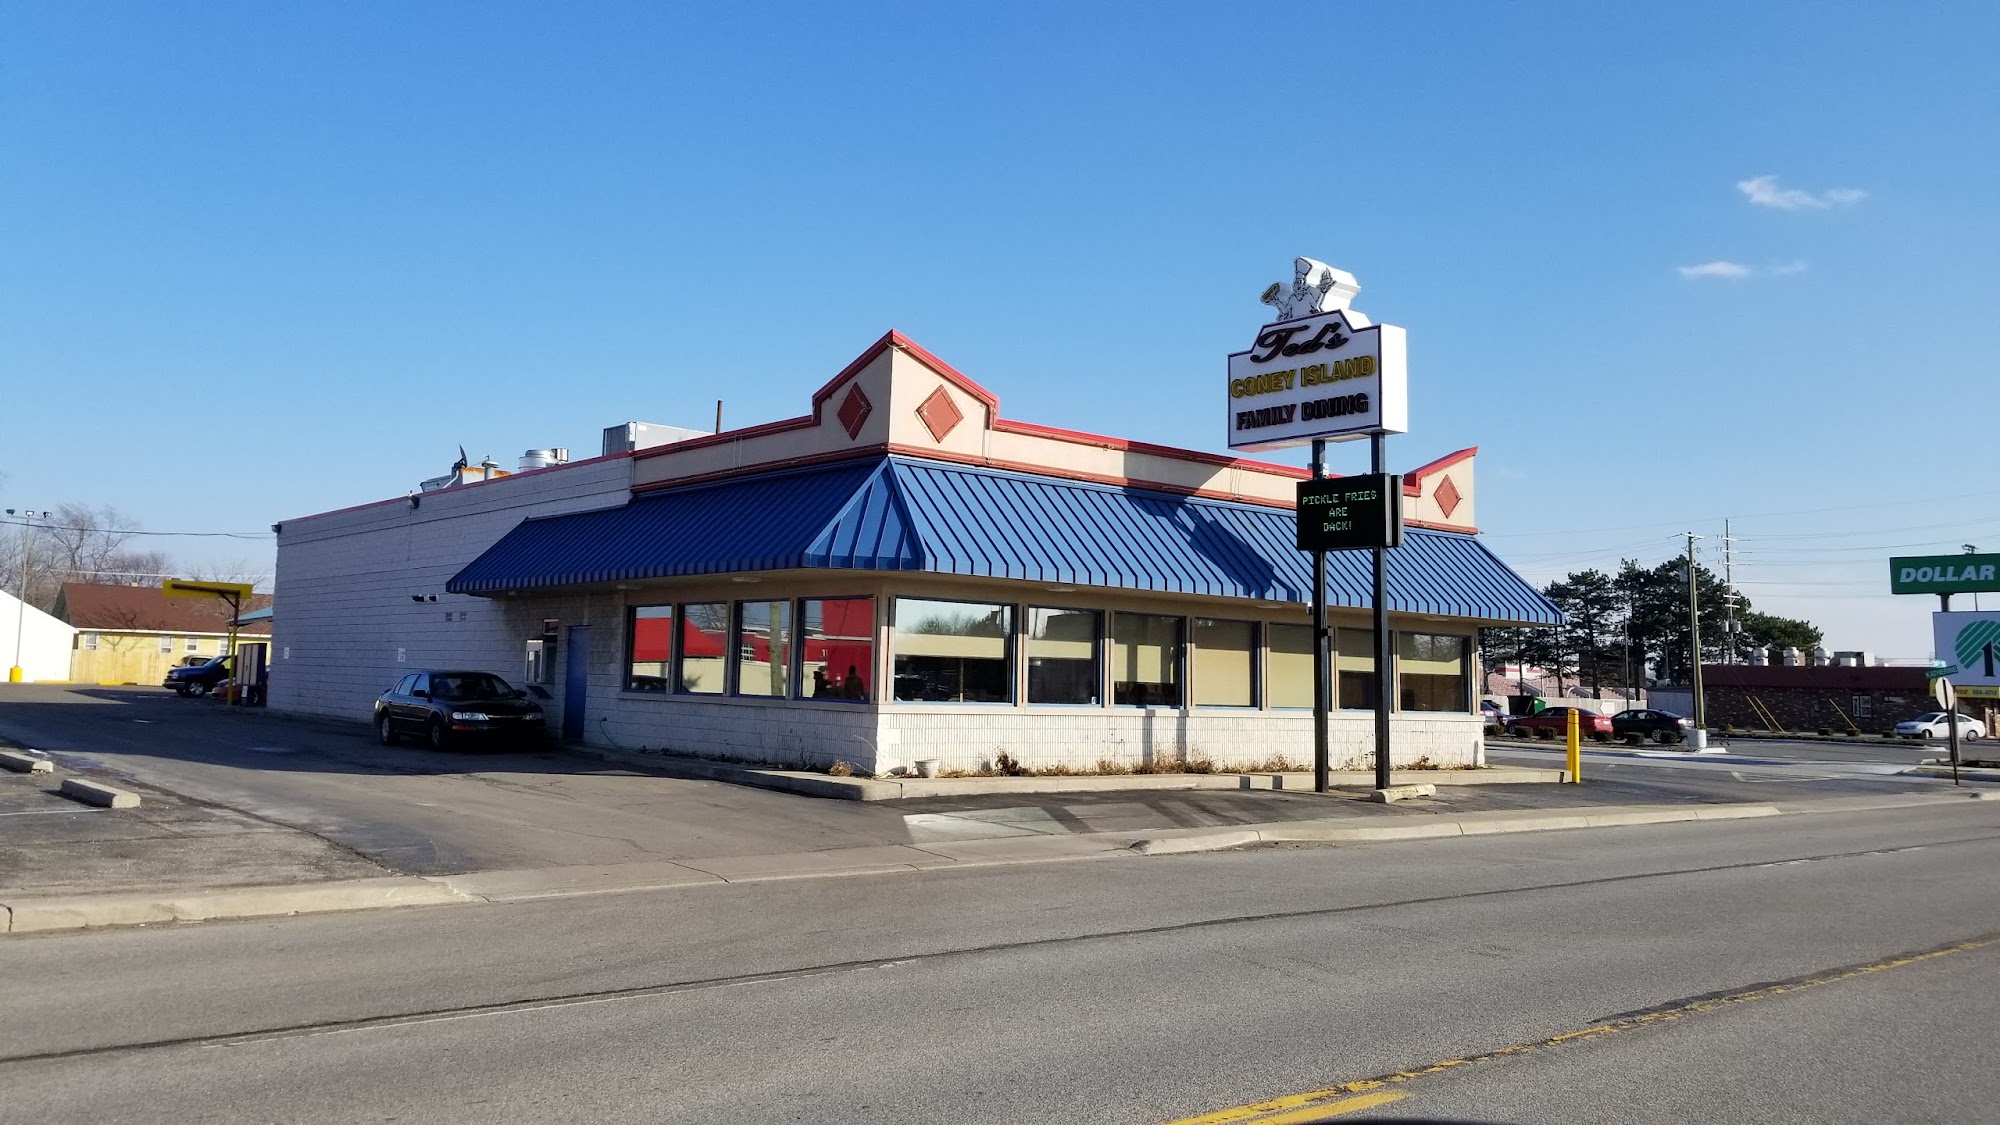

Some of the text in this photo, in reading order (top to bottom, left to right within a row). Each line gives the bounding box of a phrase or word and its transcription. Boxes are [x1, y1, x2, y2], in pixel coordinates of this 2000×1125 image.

[1250, 321, 1349, 363] Ted's
[1231, 355, 1376, 399] CONEY ISLAND
[1236, 393, 1369, 430] FAMILY DINING
[1302, 490, 1377, 505] PICKLE FRIES
[1329, 507, 1348, 517] ARE
[1900, 565, 1995, 582] DOLLAR
